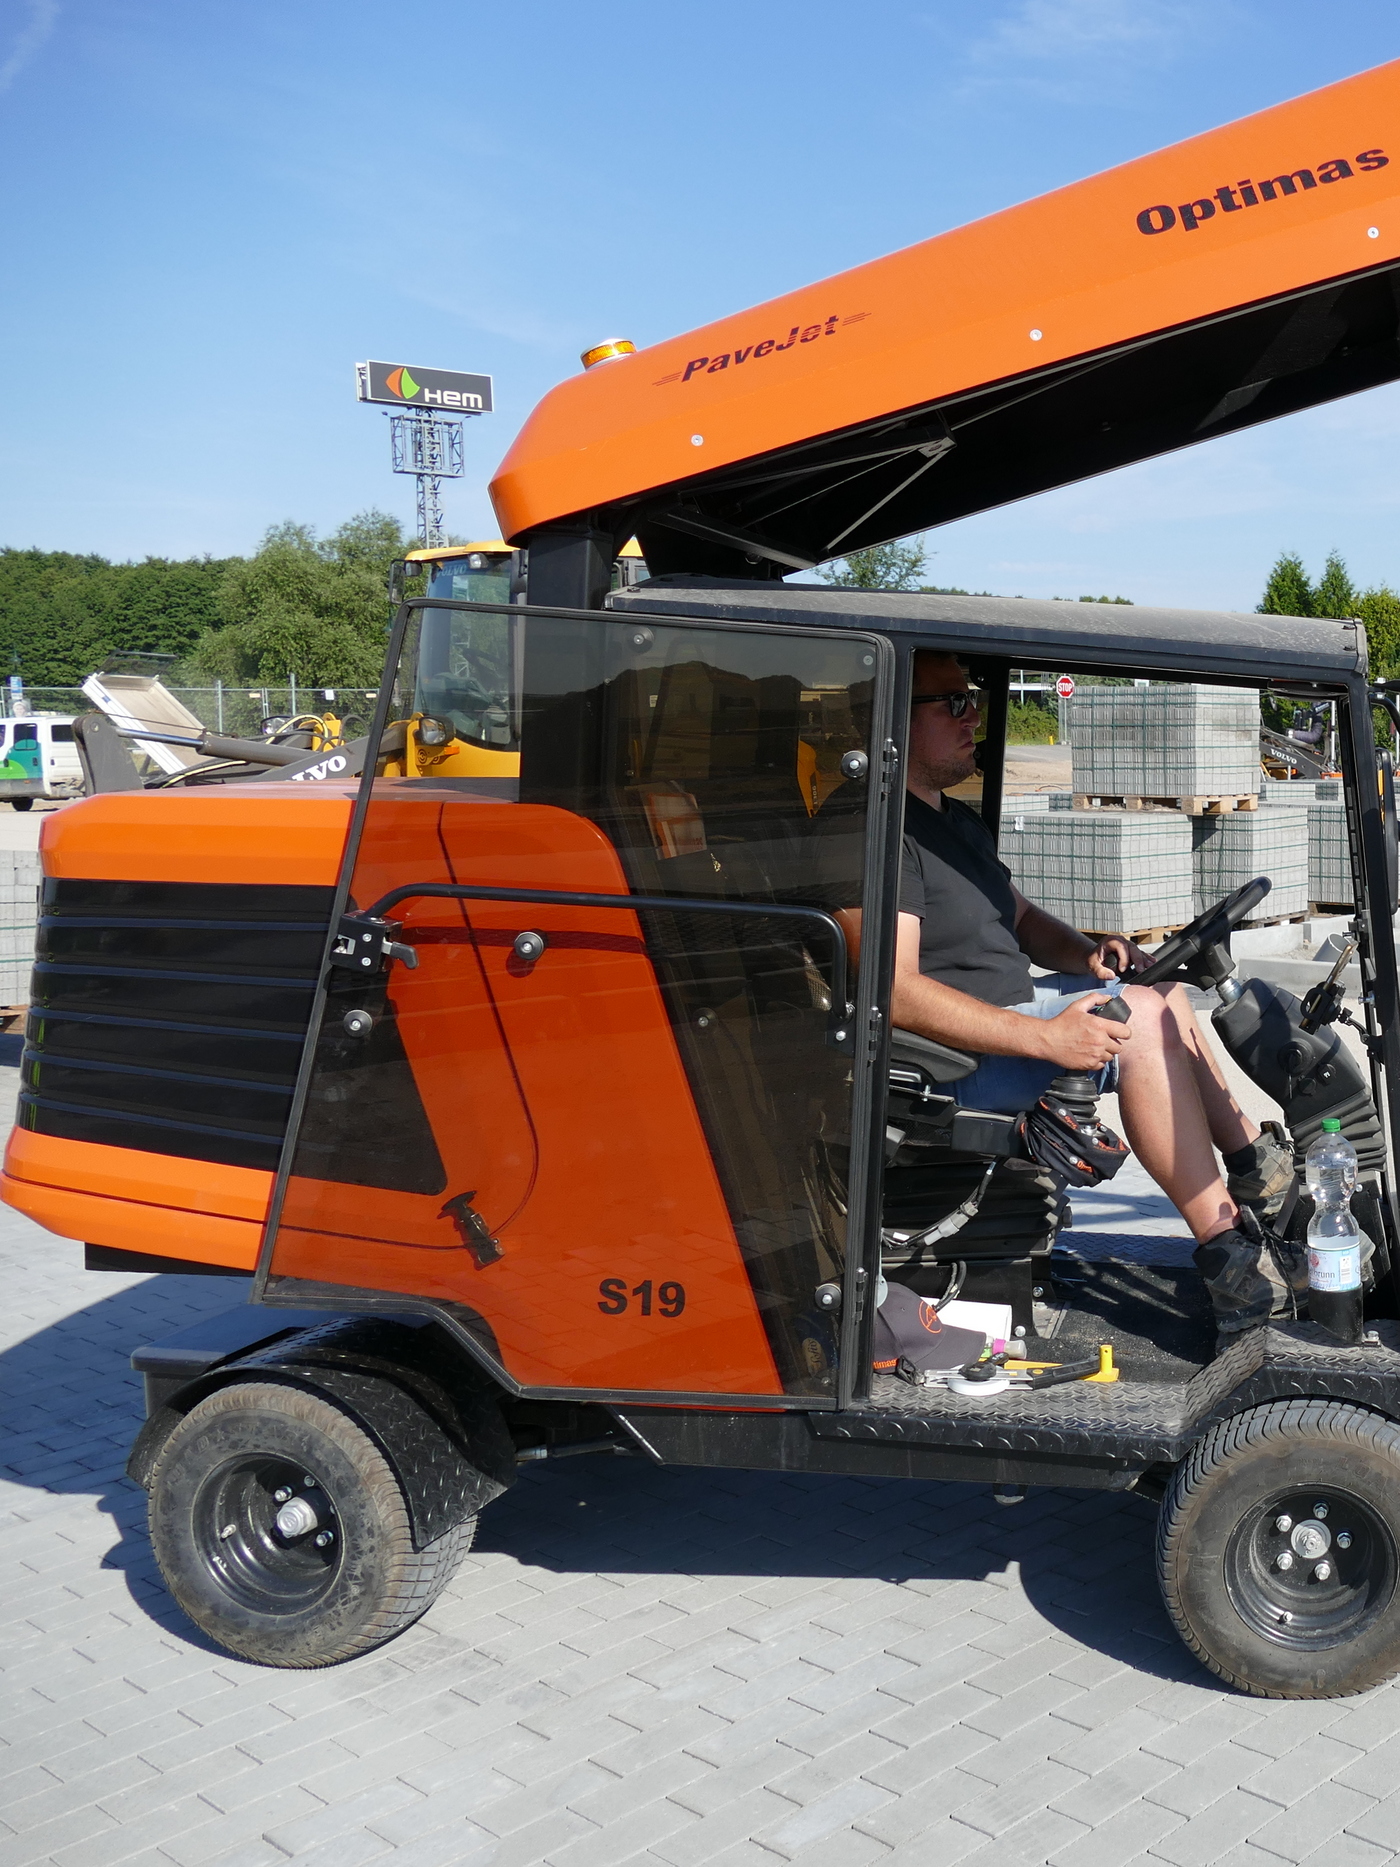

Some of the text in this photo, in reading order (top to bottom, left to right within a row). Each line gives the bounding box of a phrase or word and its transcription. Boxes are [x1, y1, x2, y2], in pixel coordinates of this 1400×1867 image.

[1136, 148, 1390, 236] Optimas
[681, 314, 839, 383] PaveJet
[1058, 683, 1073, 692] STOP
[286, 755, 347, 781] LVO
[1270, 748, 1297, 765] VOLVO
[597, 1278, 686, 1318] S19
